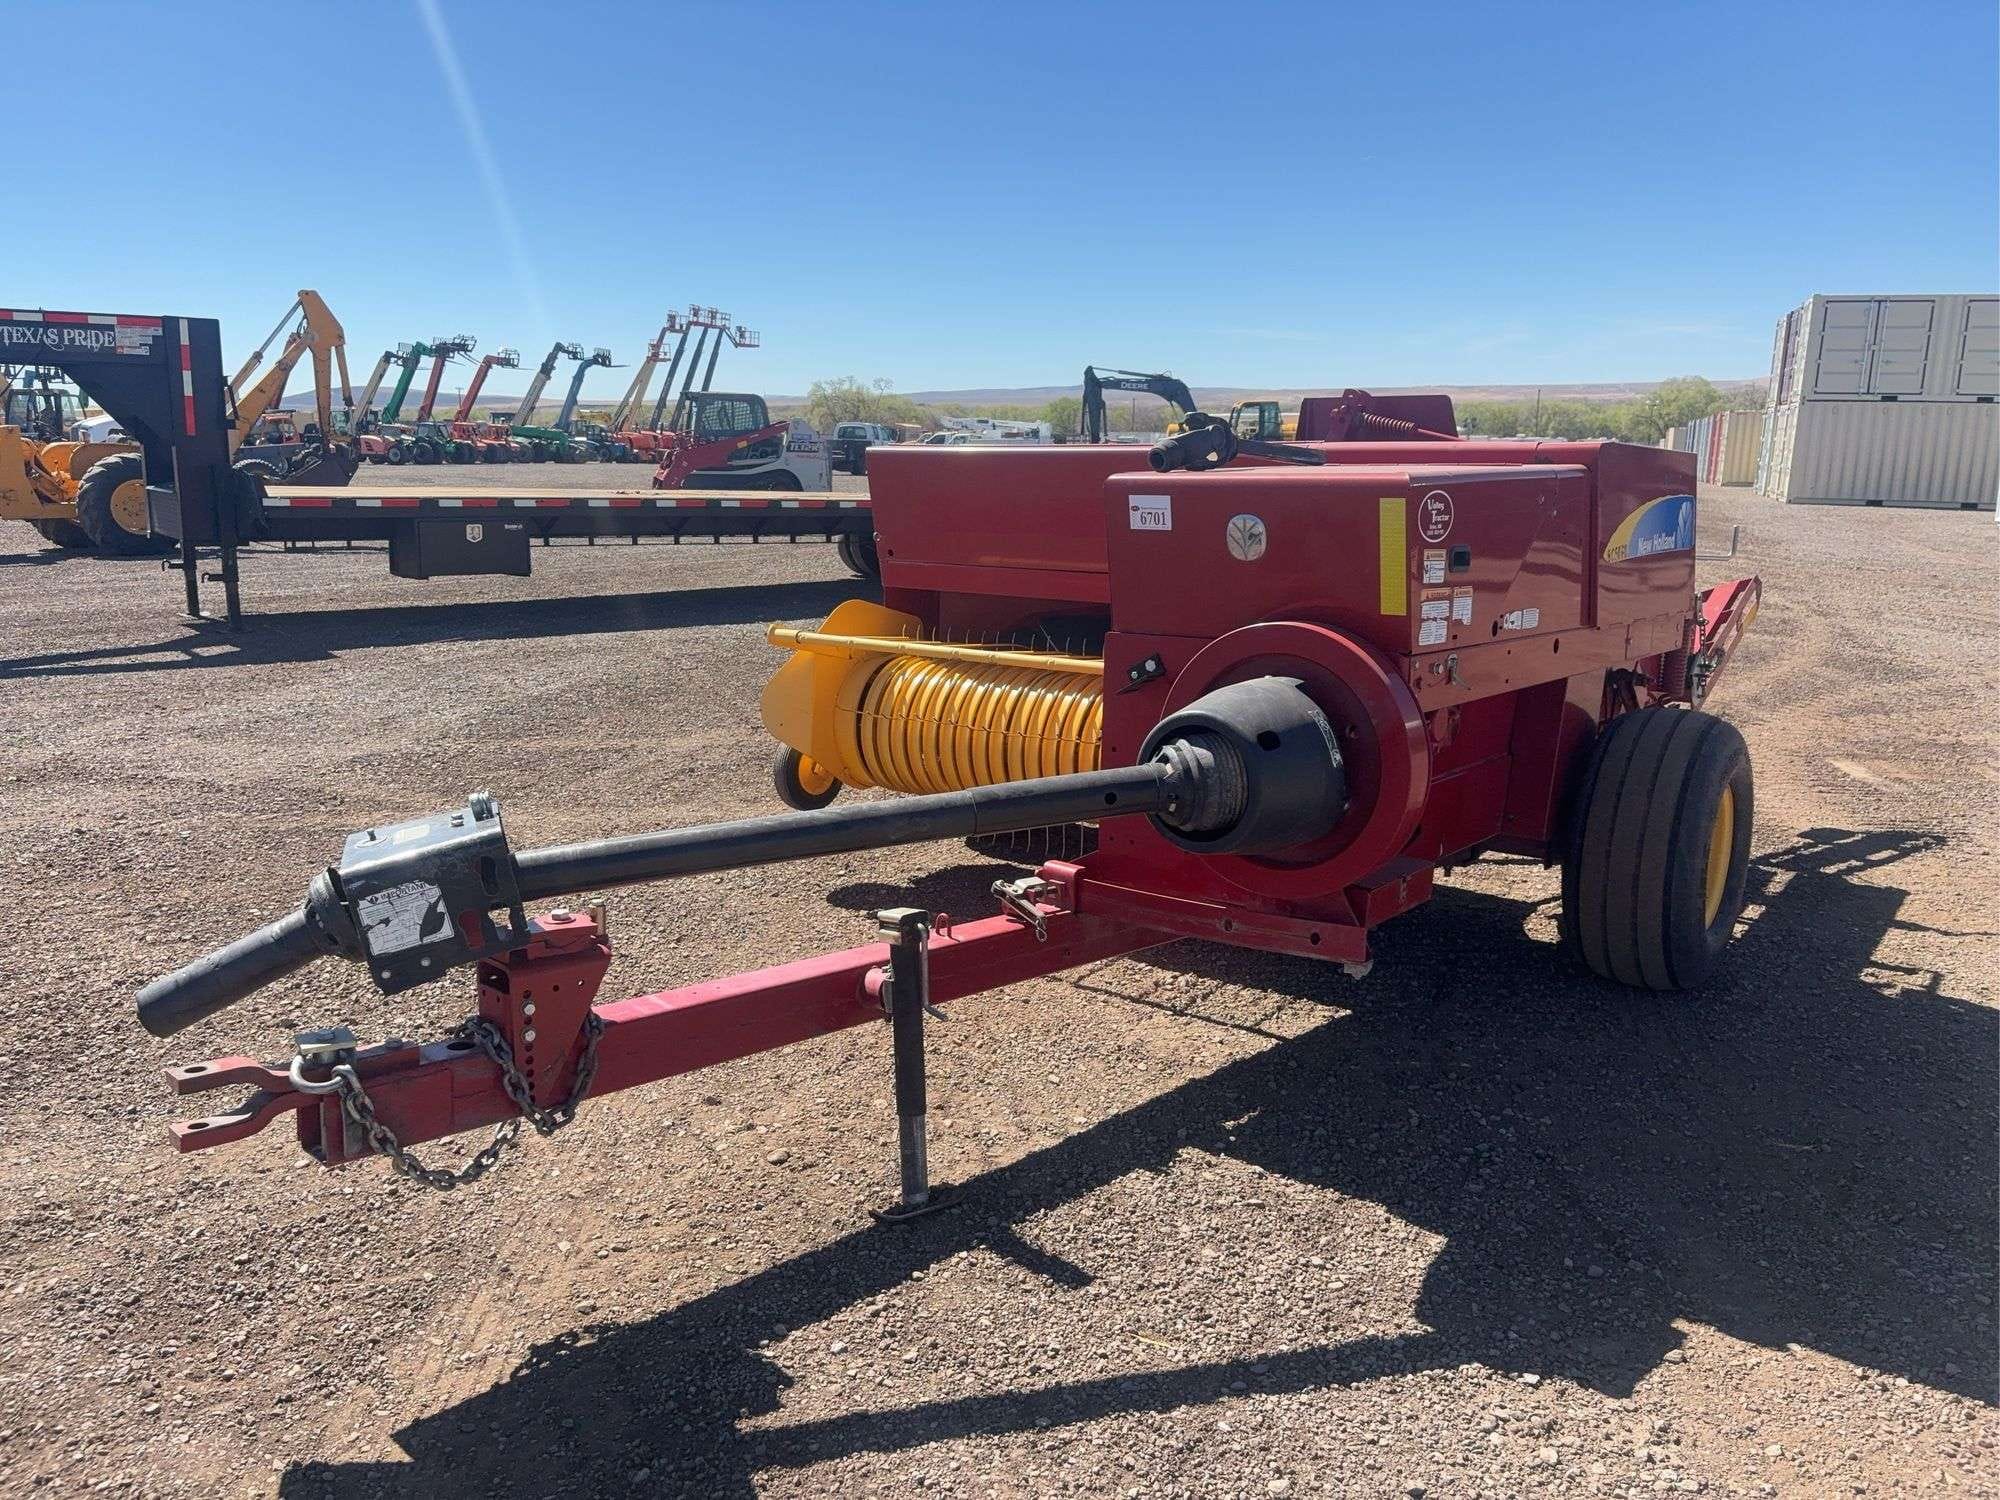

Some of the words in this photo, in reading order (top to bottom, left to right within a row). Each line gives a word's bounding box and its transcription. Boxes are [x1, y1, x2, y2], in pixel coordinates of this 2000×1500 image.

[0, 325, 64, 350] TEXAS
[63, 328, 116, 352] PRIDE
[1120, 381, 1150, 390] DEERE
[1140, 511, 1168, 526] 6701
[1638, 536, 1653, 555] New
[1653, 531, 1676, 552] Holland
